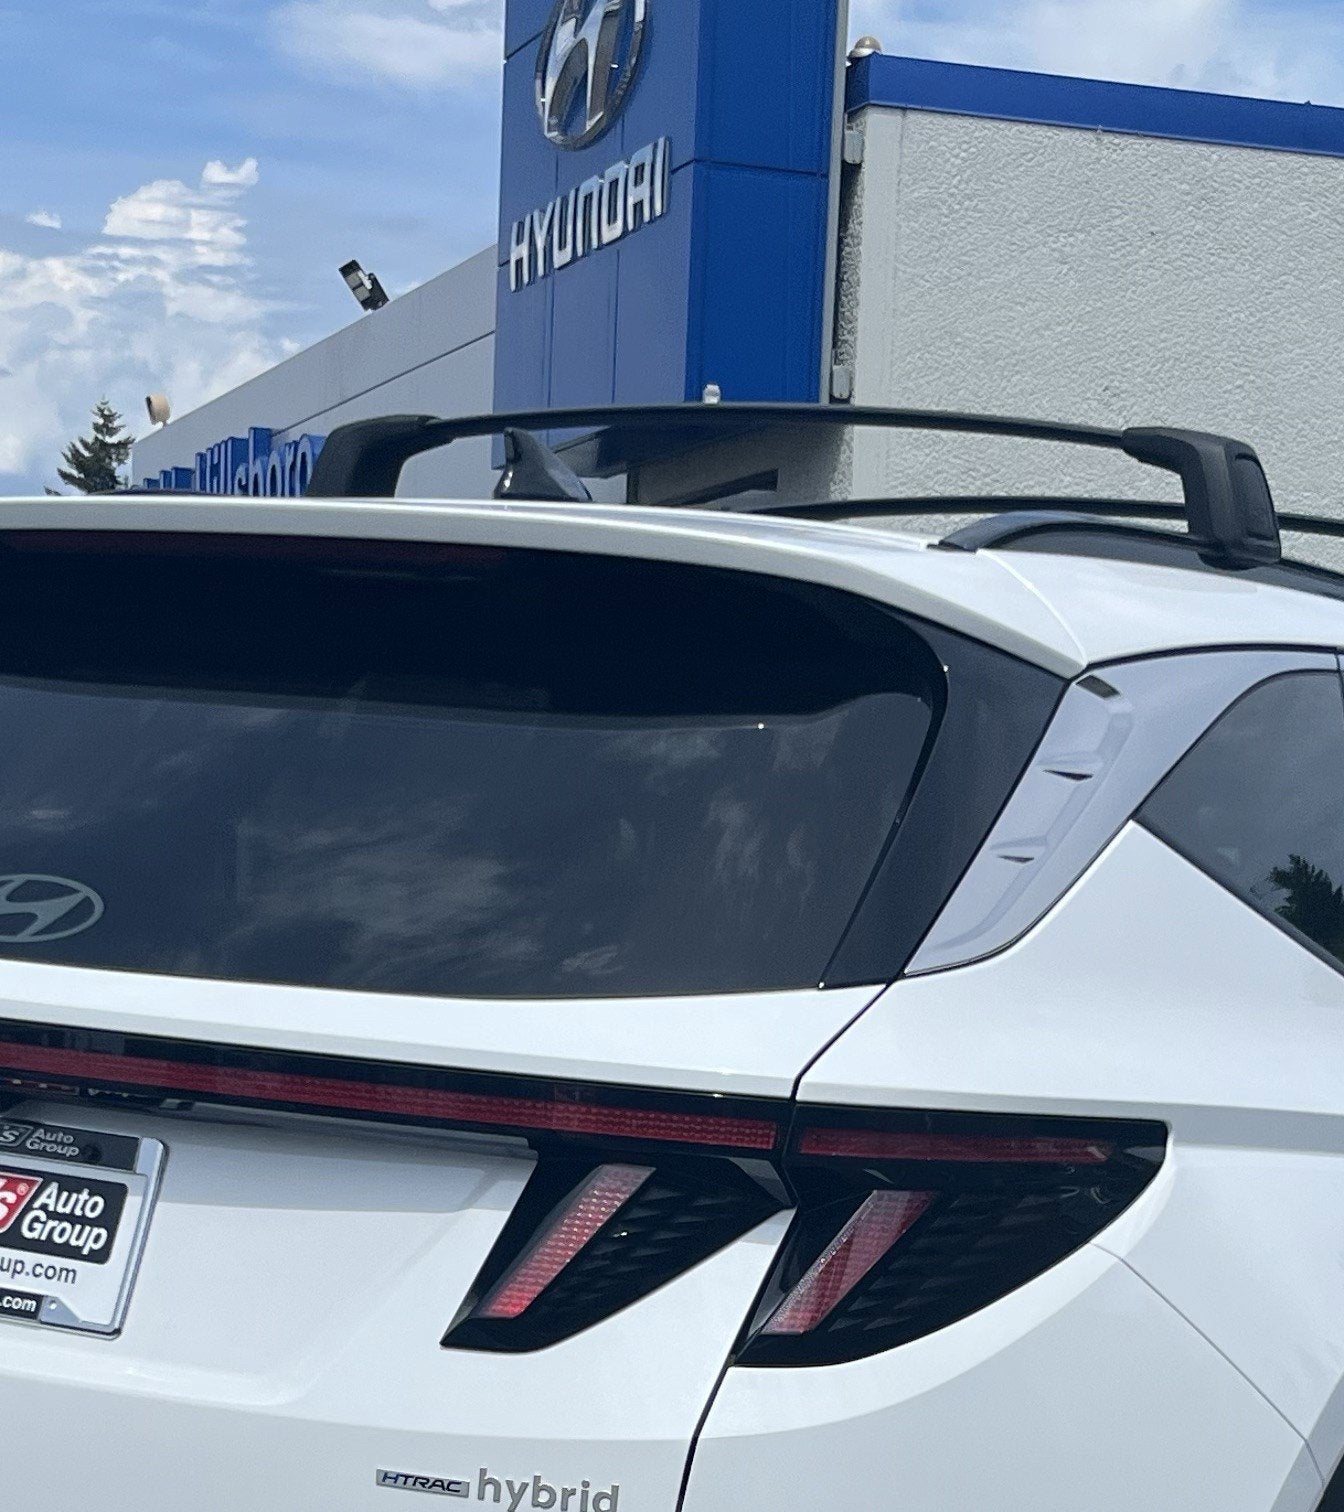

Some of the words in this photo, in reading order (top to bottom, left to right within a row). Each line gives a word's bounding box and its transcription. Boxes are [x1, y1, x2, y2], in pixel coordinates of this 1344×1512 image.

[509, 137, 671, 293] HYUNDAI
[25, 1137, 80, 1158] Group
[33, 1128, 76, 1143] Auto
[32, 1182, 105, 1219] Auto
[21, 1211, 109, 1255] Group
[381, 1472, 462, 1493] HTRAC
